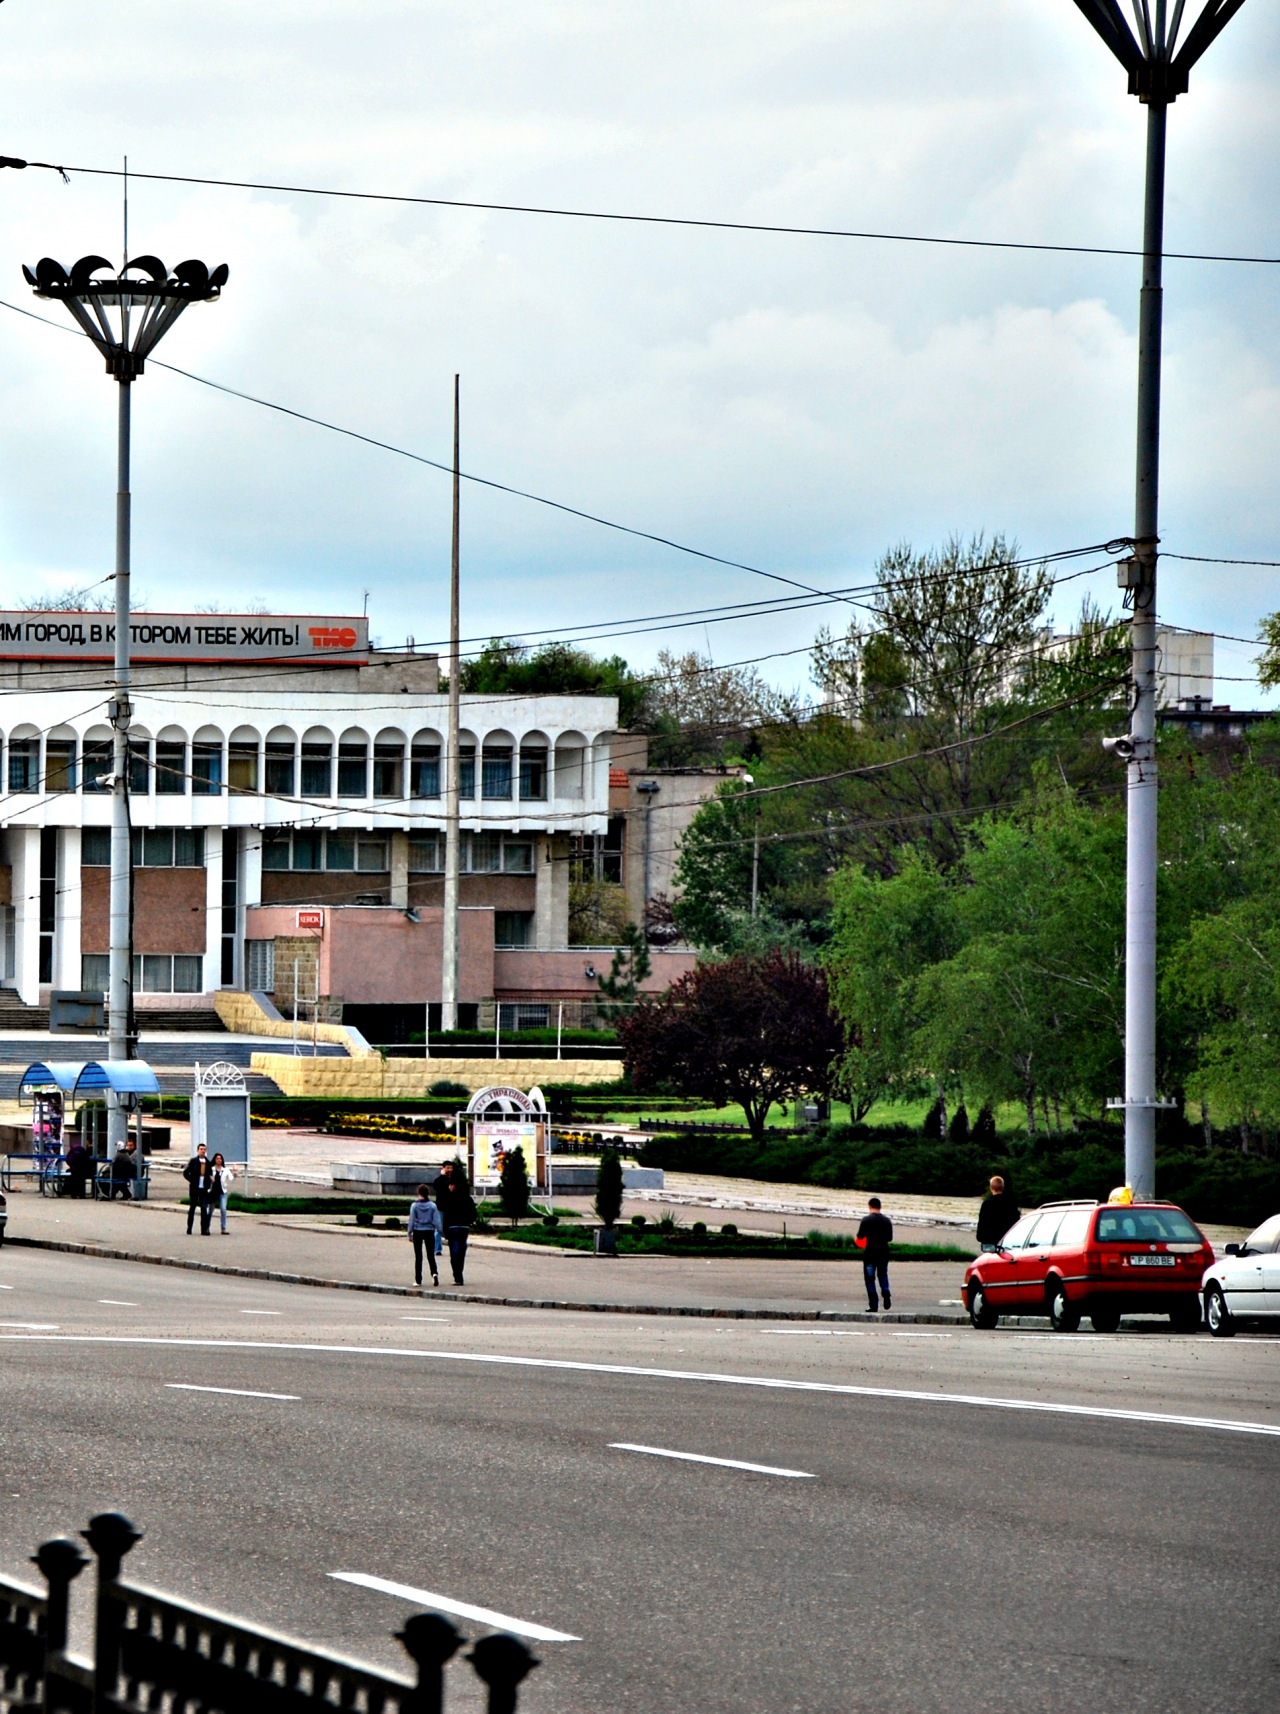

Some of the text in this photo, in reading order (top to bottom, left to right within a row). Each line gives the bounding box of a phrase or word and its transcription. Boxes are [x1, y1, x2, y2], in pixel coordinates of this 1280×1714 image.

[25, 624, 86, 645] ГОРОД,
[90, 625, 102, 642] В
[106, 625, 190, 644] КТОРОМ
[194, 626, 236, 645] ТЕБЕ
[240, 624, 299, 646] ЖИТЬ!
